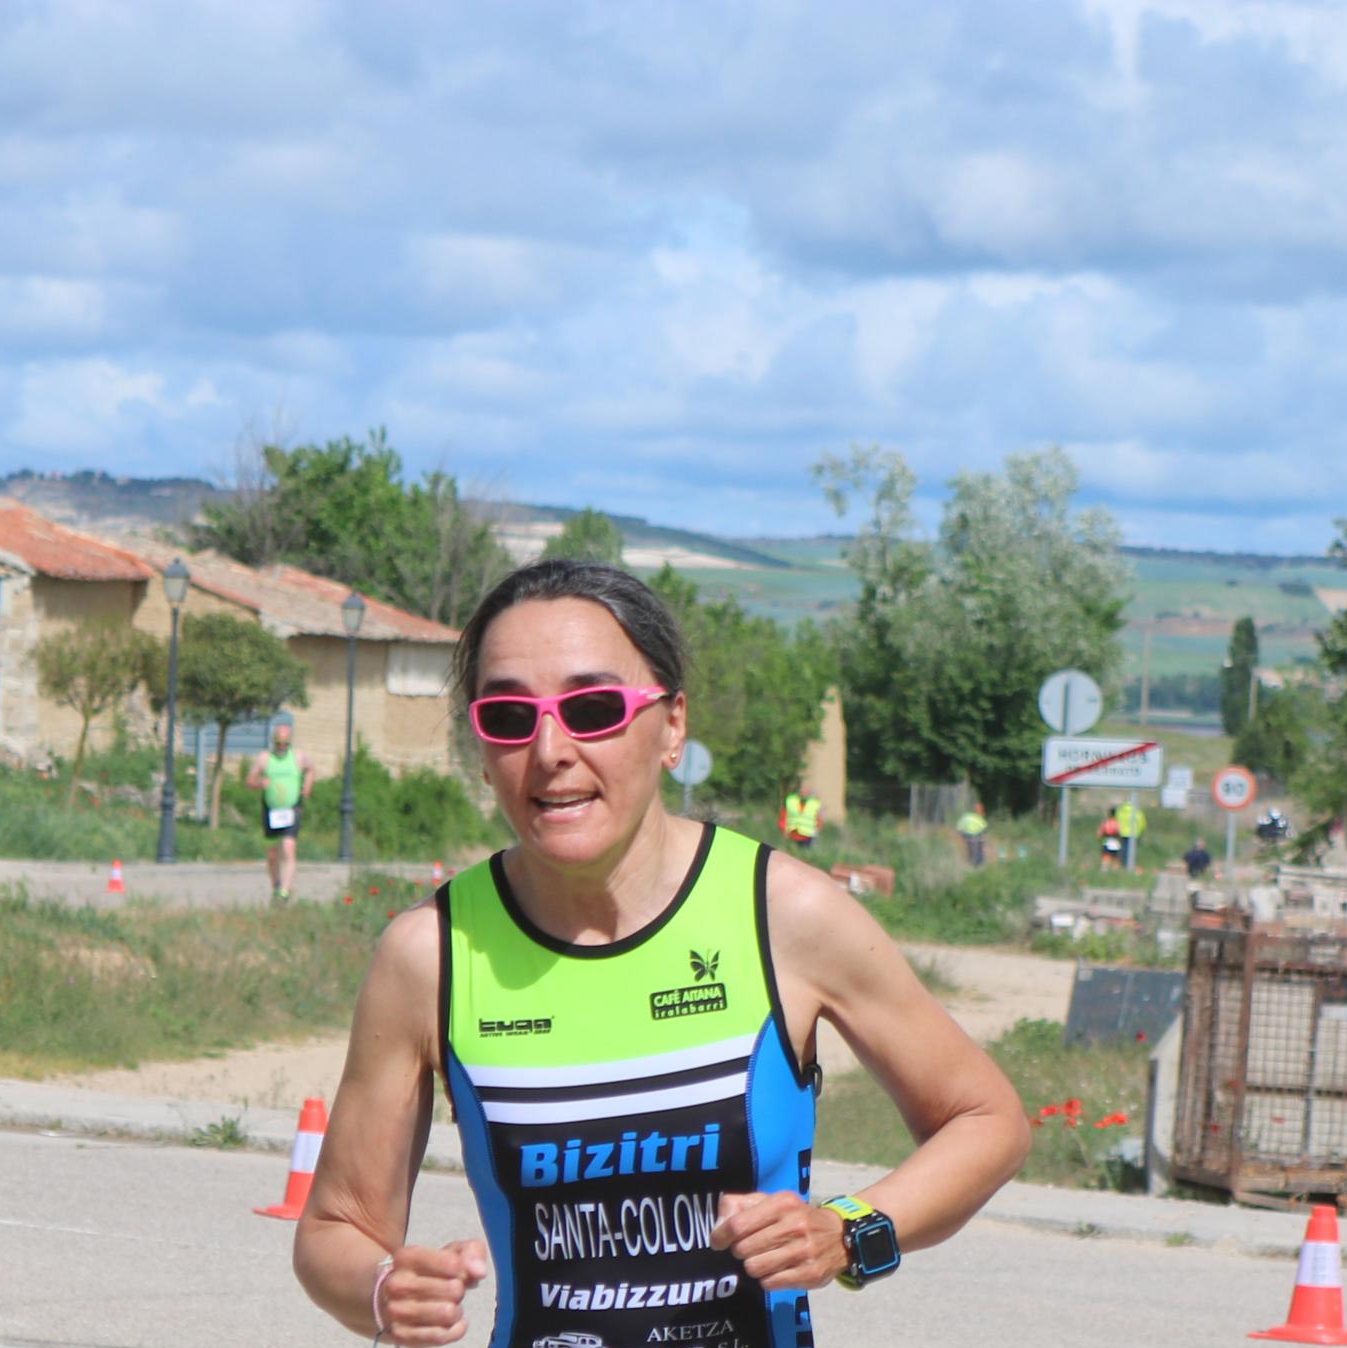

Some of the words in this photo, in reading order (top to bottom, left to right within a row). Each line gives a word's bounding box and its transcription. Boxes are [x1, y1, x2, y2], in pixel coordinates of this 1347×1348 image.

[653, 989, 681, 1008] CAFÉ
[520, 1123, 721, 1188] Bizitri
[534, 1192, 725, 1261] SANTA-COLOM
[540, 1274, 739, 1312] Viabizzuno
[646, 1319, 735, 1343] AKETZA
